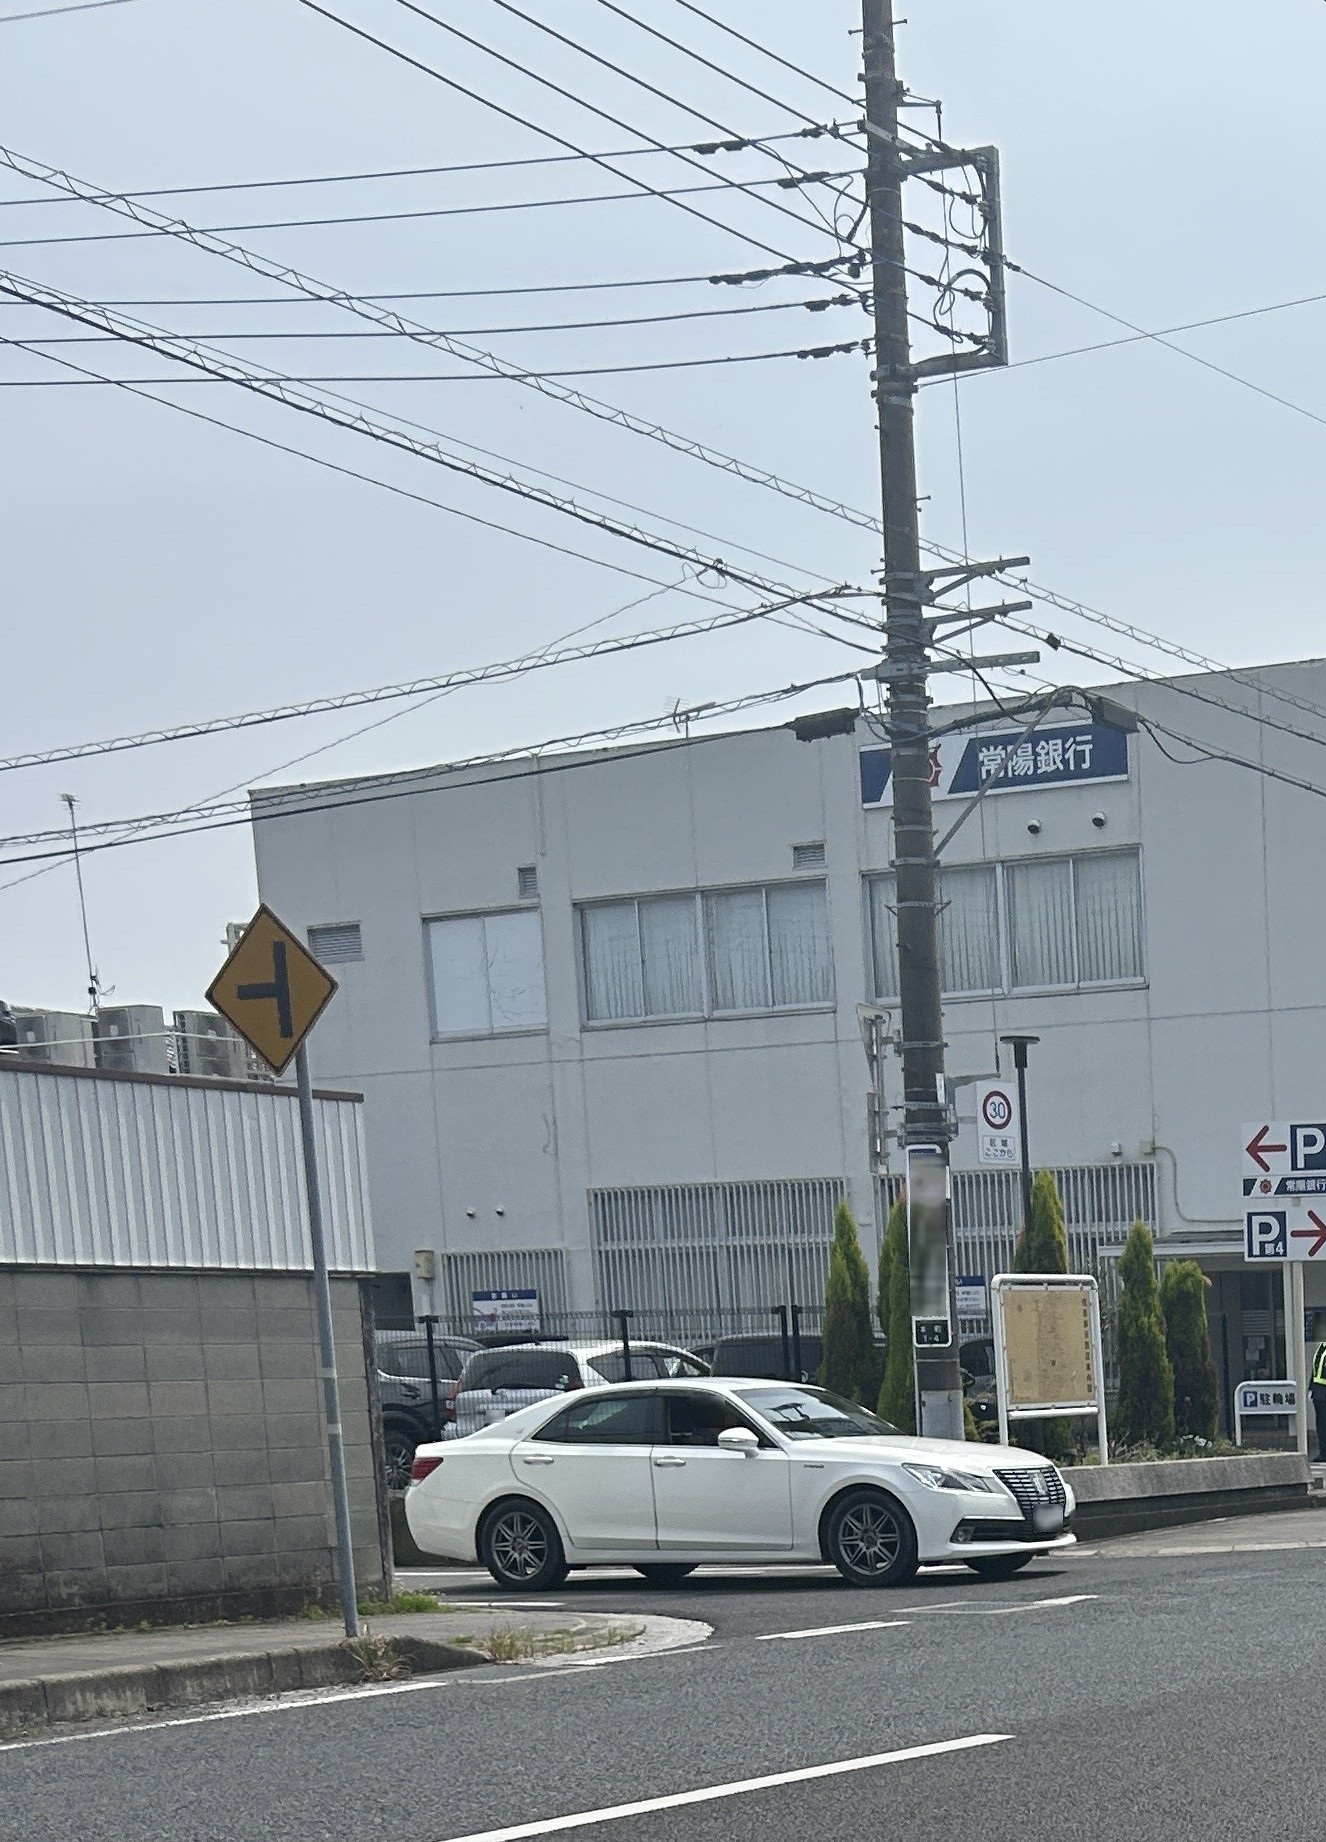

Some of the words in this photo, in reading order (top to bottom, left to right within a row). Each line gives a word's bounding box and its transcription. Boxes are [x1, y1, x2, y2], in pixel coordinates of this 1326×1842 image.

[978, 734, 1094, 779] 常陽銀行
[989, 1101, 1006, 1119] 30
[1296, 1127, 1325, 1169] P
[1251, 1215, 1280, 1256] P
